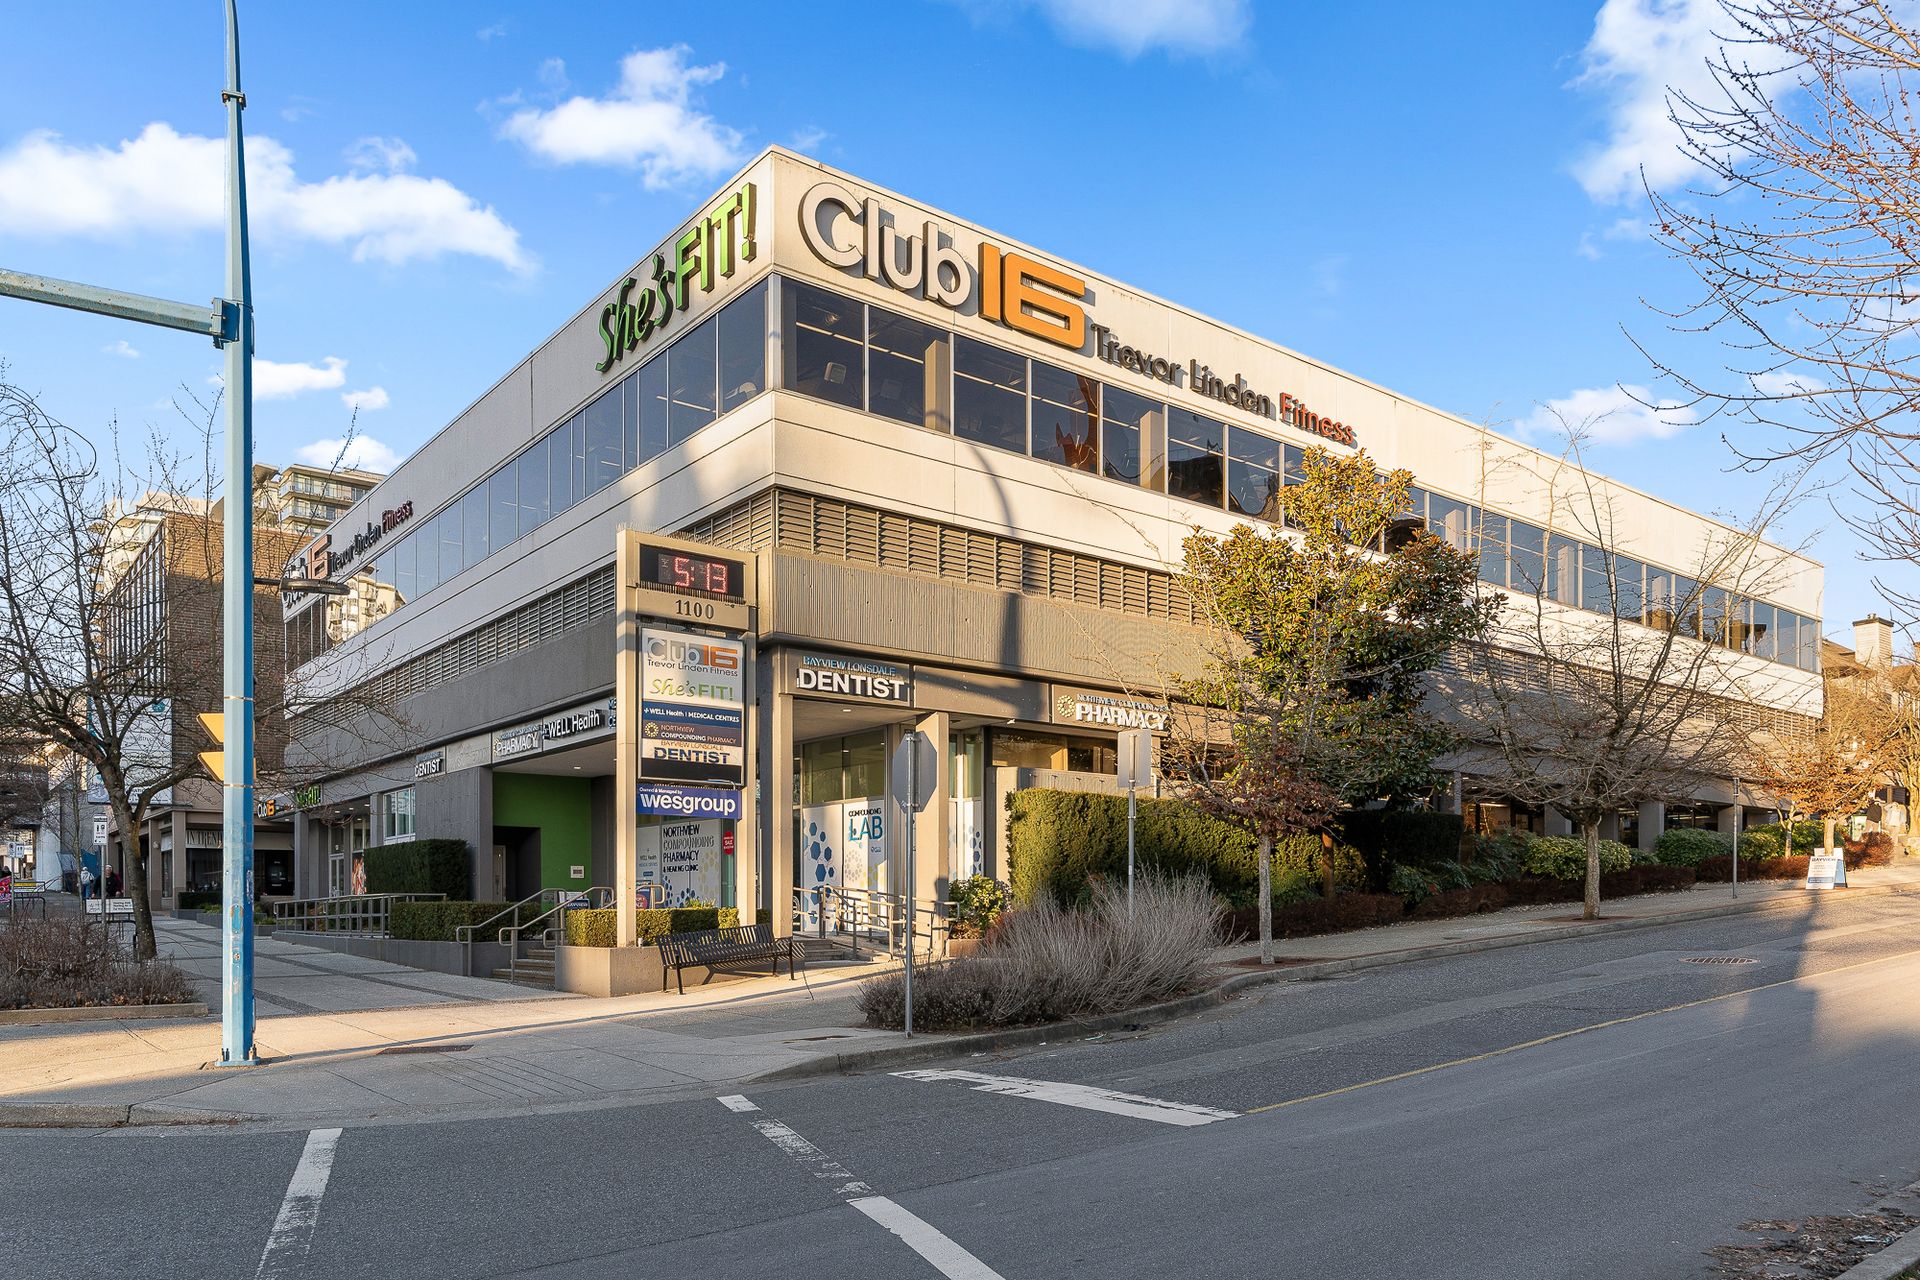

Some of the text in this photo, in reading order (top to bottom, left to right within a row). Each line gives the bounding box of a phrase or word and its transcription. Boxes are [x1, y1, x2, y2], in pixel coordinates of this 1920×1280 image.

[675, 182, 757, 312] FIT!
[1091, 323, 1358, 446] Trevor Linden Fitness
[382, 500, 413, 534] Fitness
[674, 556, 728, 594] 5:13
[675, 599, 714, 619] 1100
[648, 659, 738, 677] Trevor Linden Fitness
[803, 656, 896, 676] BAYVIEW LONSDALE
[649, 678, 733, 701] She's FIT!
[798, 668, 905, 699] DENTIST
[548, 717, 571, 738] WELL
[572, 709, 600, 732] Health
[650, 708, 665, 716] WELL
[688, 711, 714, 720] MEDICAL
[1075, 702, 1169, 731] PHARMACY
[661, 724, 695, 733] NORTHVIEW
[661, 732, 706, 741] COMPOUNDING
[496, 731, 538, 757] PHARMACY
[654, 747, 730, 764] DENTIST
[640, 793, 736, 815] wesgroup
[849, 816, 883, 841] LAB
[663, 850, 700, 863] PHARMACY
